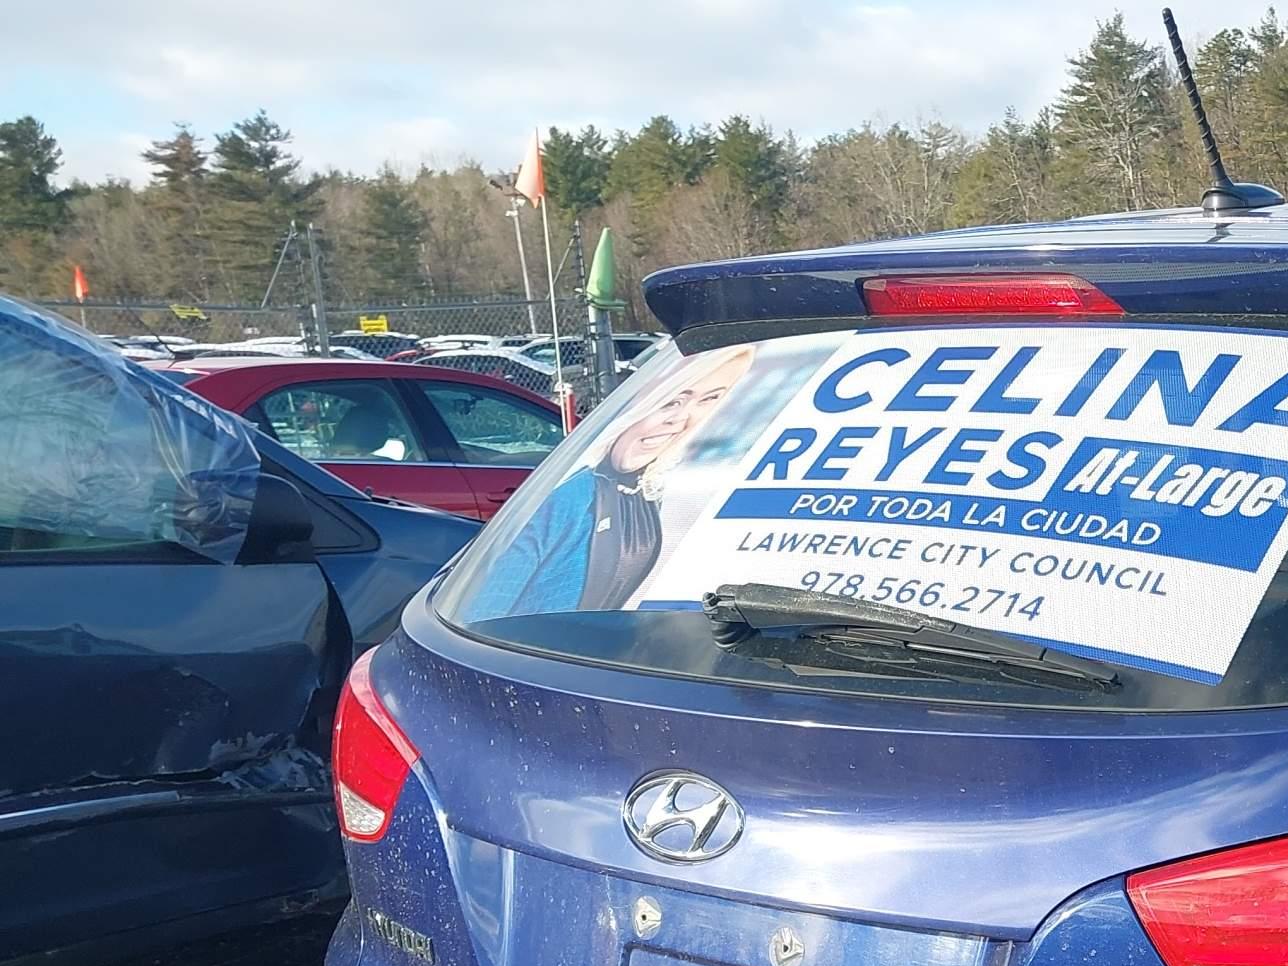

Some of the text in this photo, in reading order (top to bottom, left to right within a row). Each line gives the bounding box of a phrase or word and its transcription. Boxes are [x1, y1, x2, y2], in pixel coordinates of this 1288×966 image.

[745, 426, 1064, 490] REYES
[1063, 447, 1288, 517] At-Large
[790, 494, 1162, 545] POR TODA LA CIUDAD
[736, 531, 1167, 597] LAWRENCE CITY COUNCIL
[800, 570, 1045, 622] 978.566.2714
